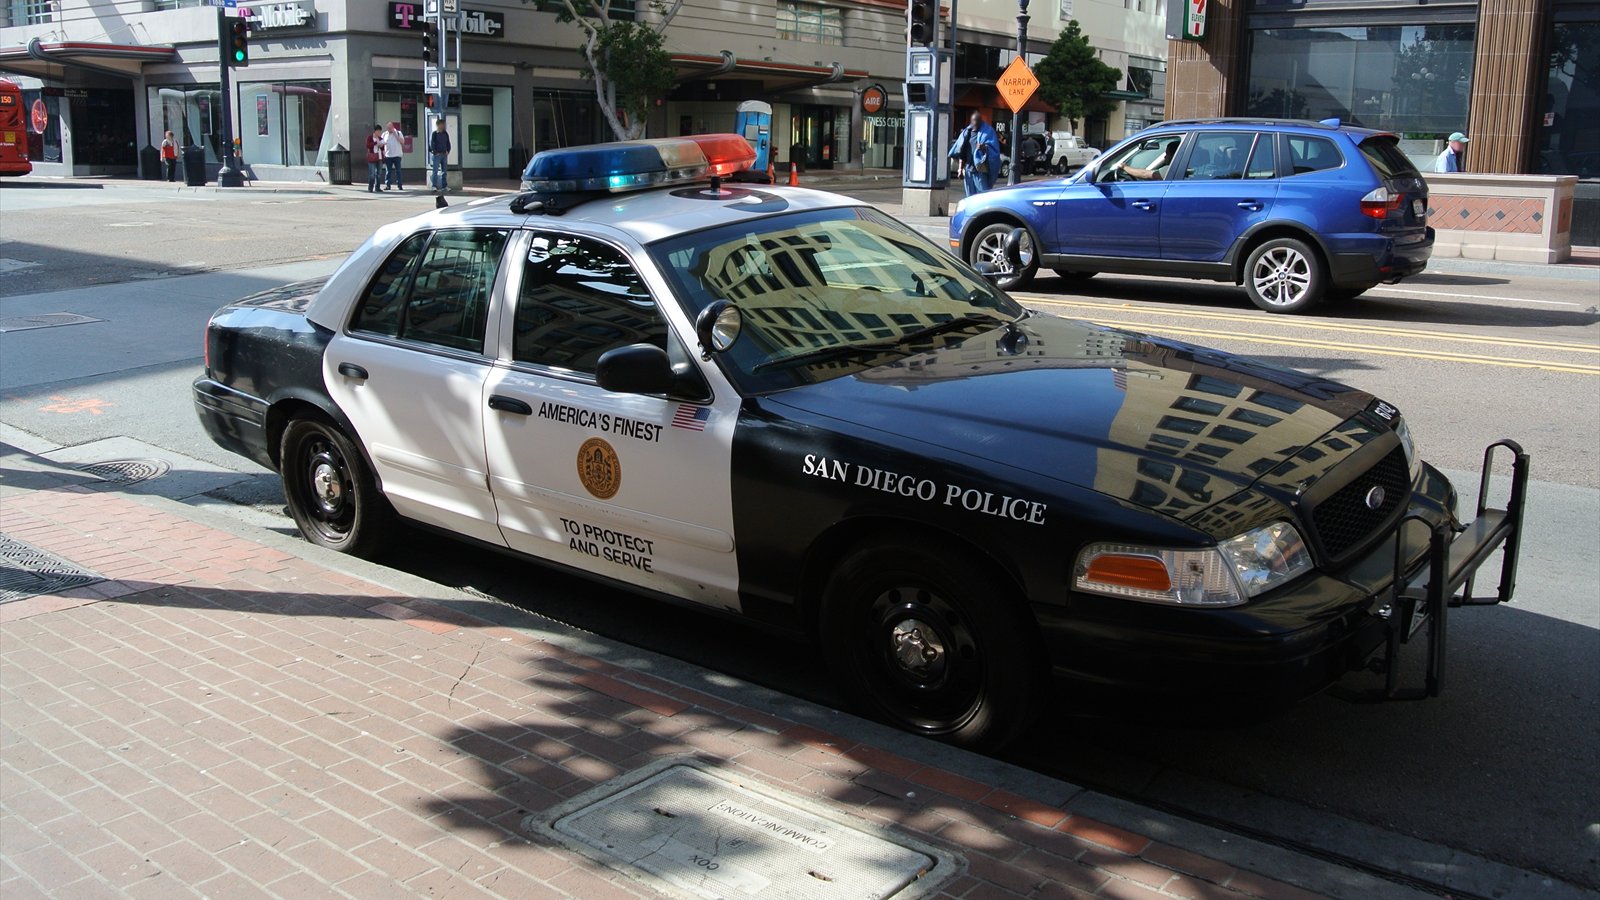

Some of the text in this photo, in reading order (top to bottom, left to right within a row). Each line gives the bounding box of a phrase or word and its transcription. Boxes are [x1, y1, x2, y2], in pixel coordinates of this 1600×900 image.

[1003, 78, 1032, 86] NARROW
[1009, 88, 1025, 96] LANE
[1, 96, 12, 104] 150
[887, 117, 906, 128] CENTE
[538, 401, 663, 442] AMERICA'S FINEST
[802, 453, 1047, 525] SAN DIEGO POLICE
[560, 517, 654, 556] TO PROTECT
[569, 537, 655, 573] AND SERVE
[717, 803, 828, 849] COMMUNICATIONS
[688, 854, 719, 871] COX
